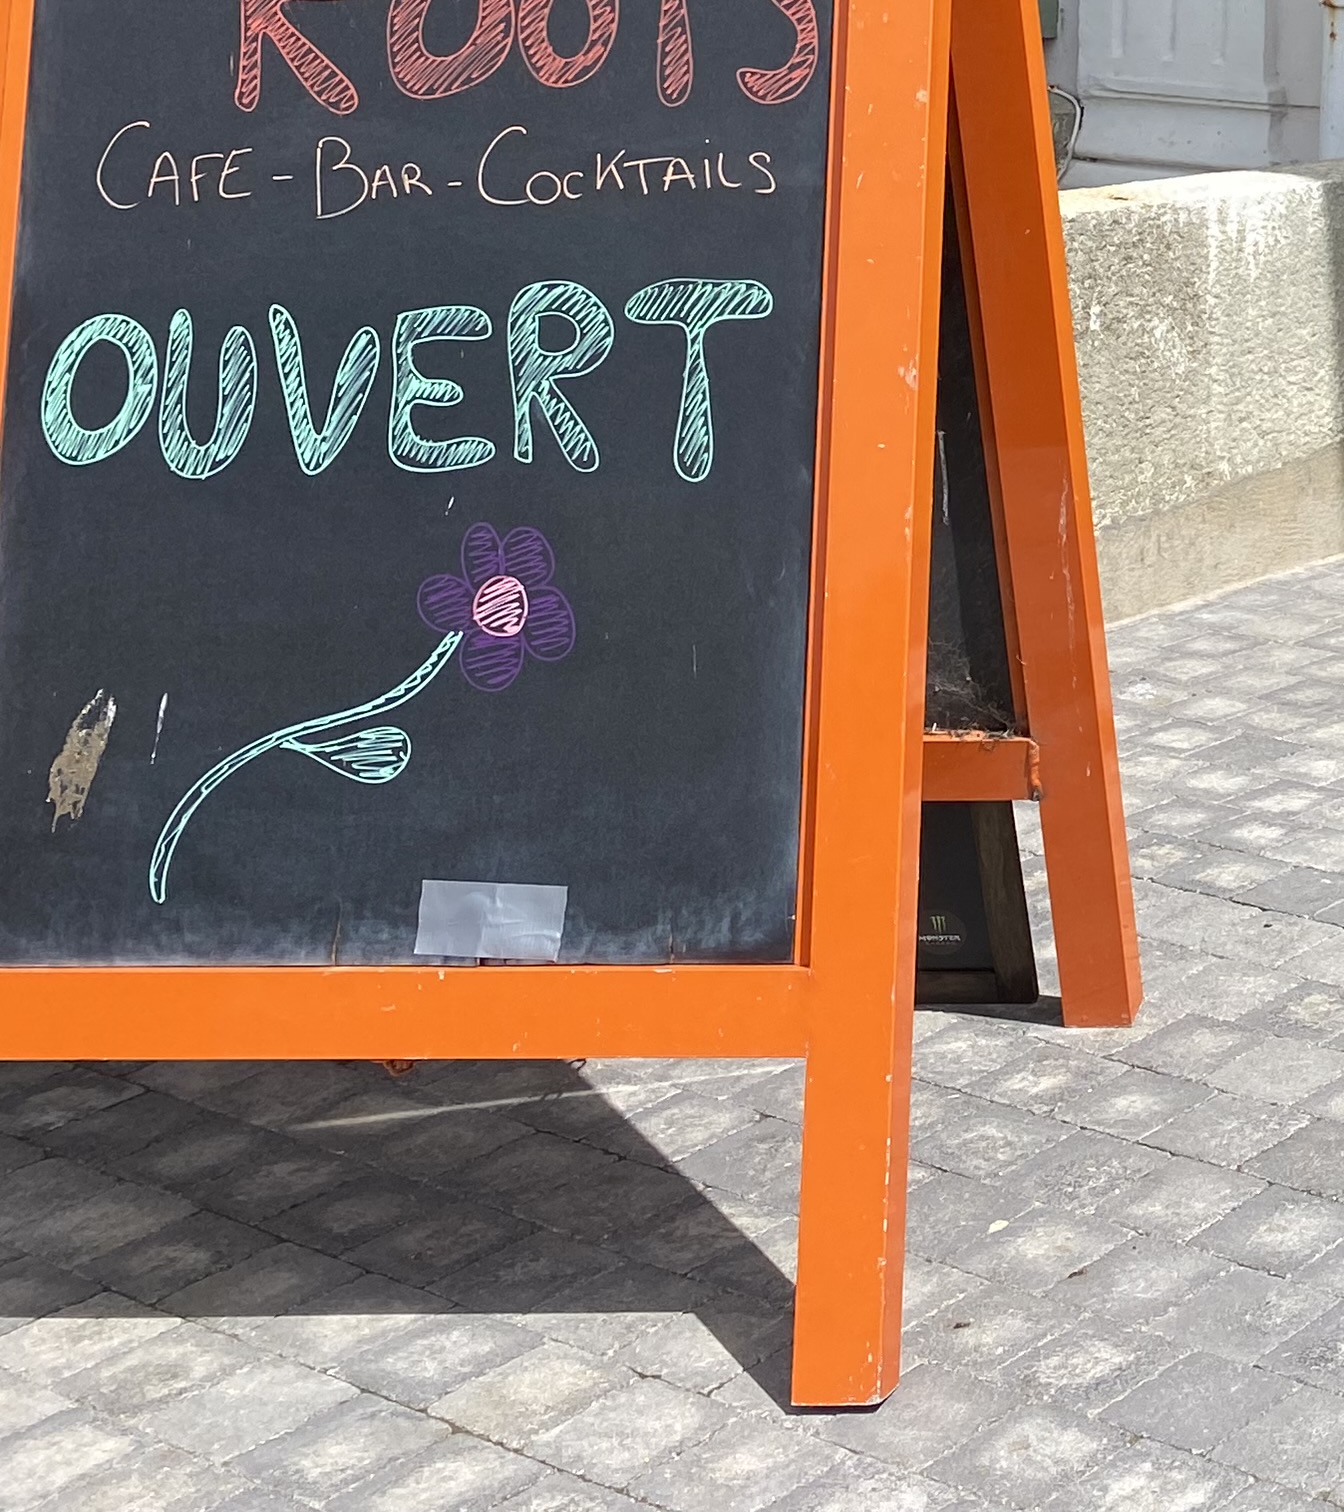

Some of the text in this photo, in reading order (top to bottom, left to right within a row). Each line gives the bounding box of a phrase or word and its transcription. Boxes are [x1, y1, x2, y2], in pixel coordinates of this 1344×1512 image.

[96, 121, 254, 211] CAFE
[314, 135, 433, 219] BAR
[40, 278, 775, 482] OUVERT
